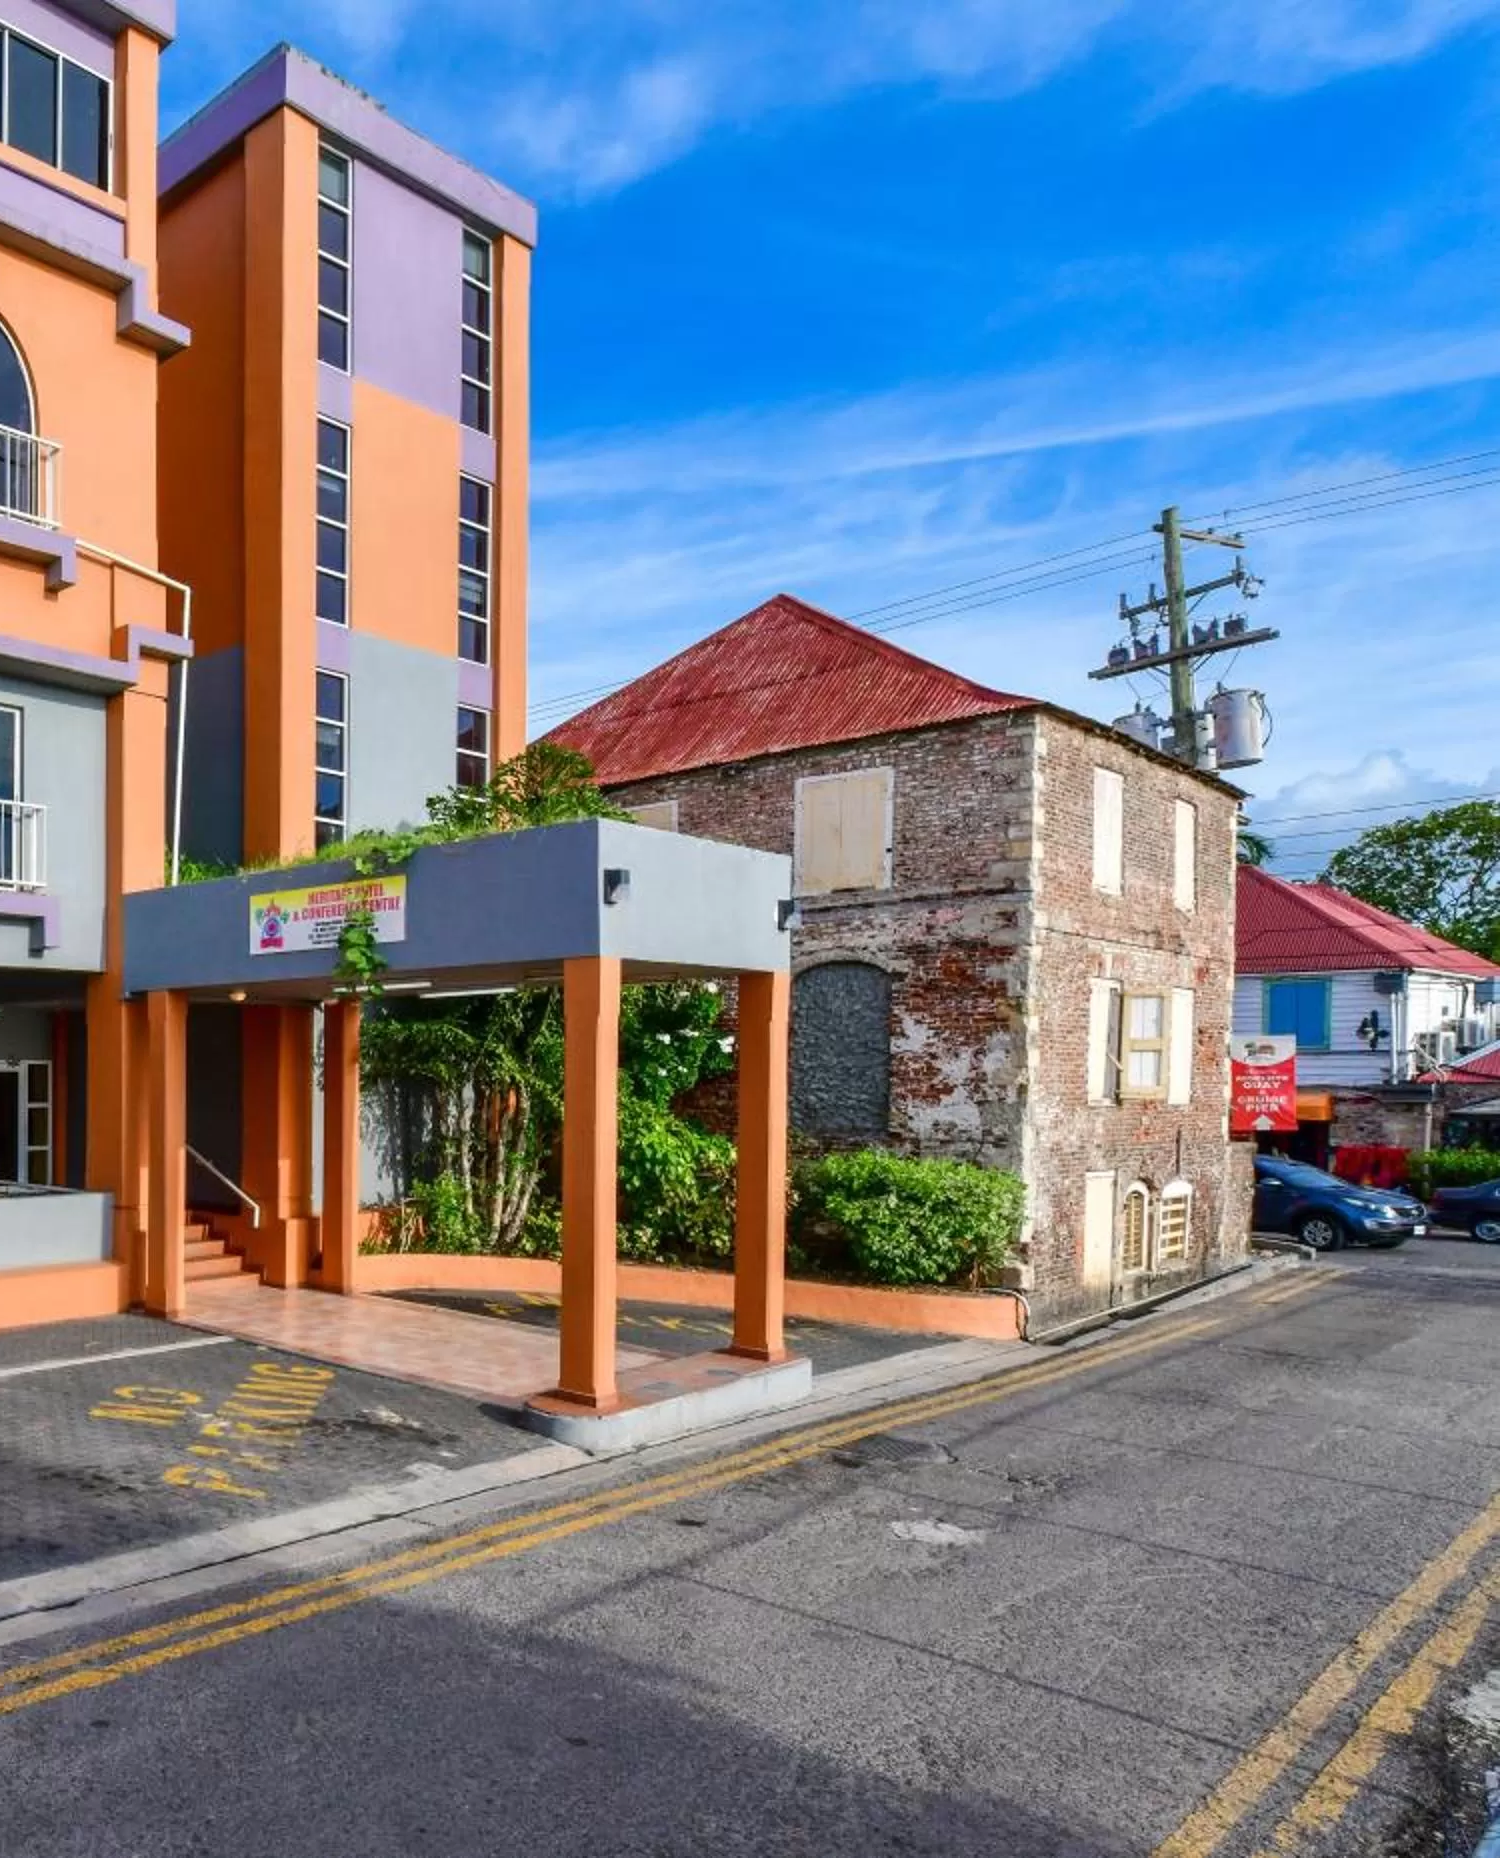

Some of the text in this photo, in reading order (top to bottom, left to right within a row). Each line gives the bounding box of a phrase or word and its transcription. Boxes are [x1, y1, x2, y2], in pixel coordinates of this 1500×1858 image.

[1242, 1081, 1281, 1089] QUAY
[1237, 1095, 1288, 1105] CRUISE
[1245, 1104, 1280, 1112] PIER
